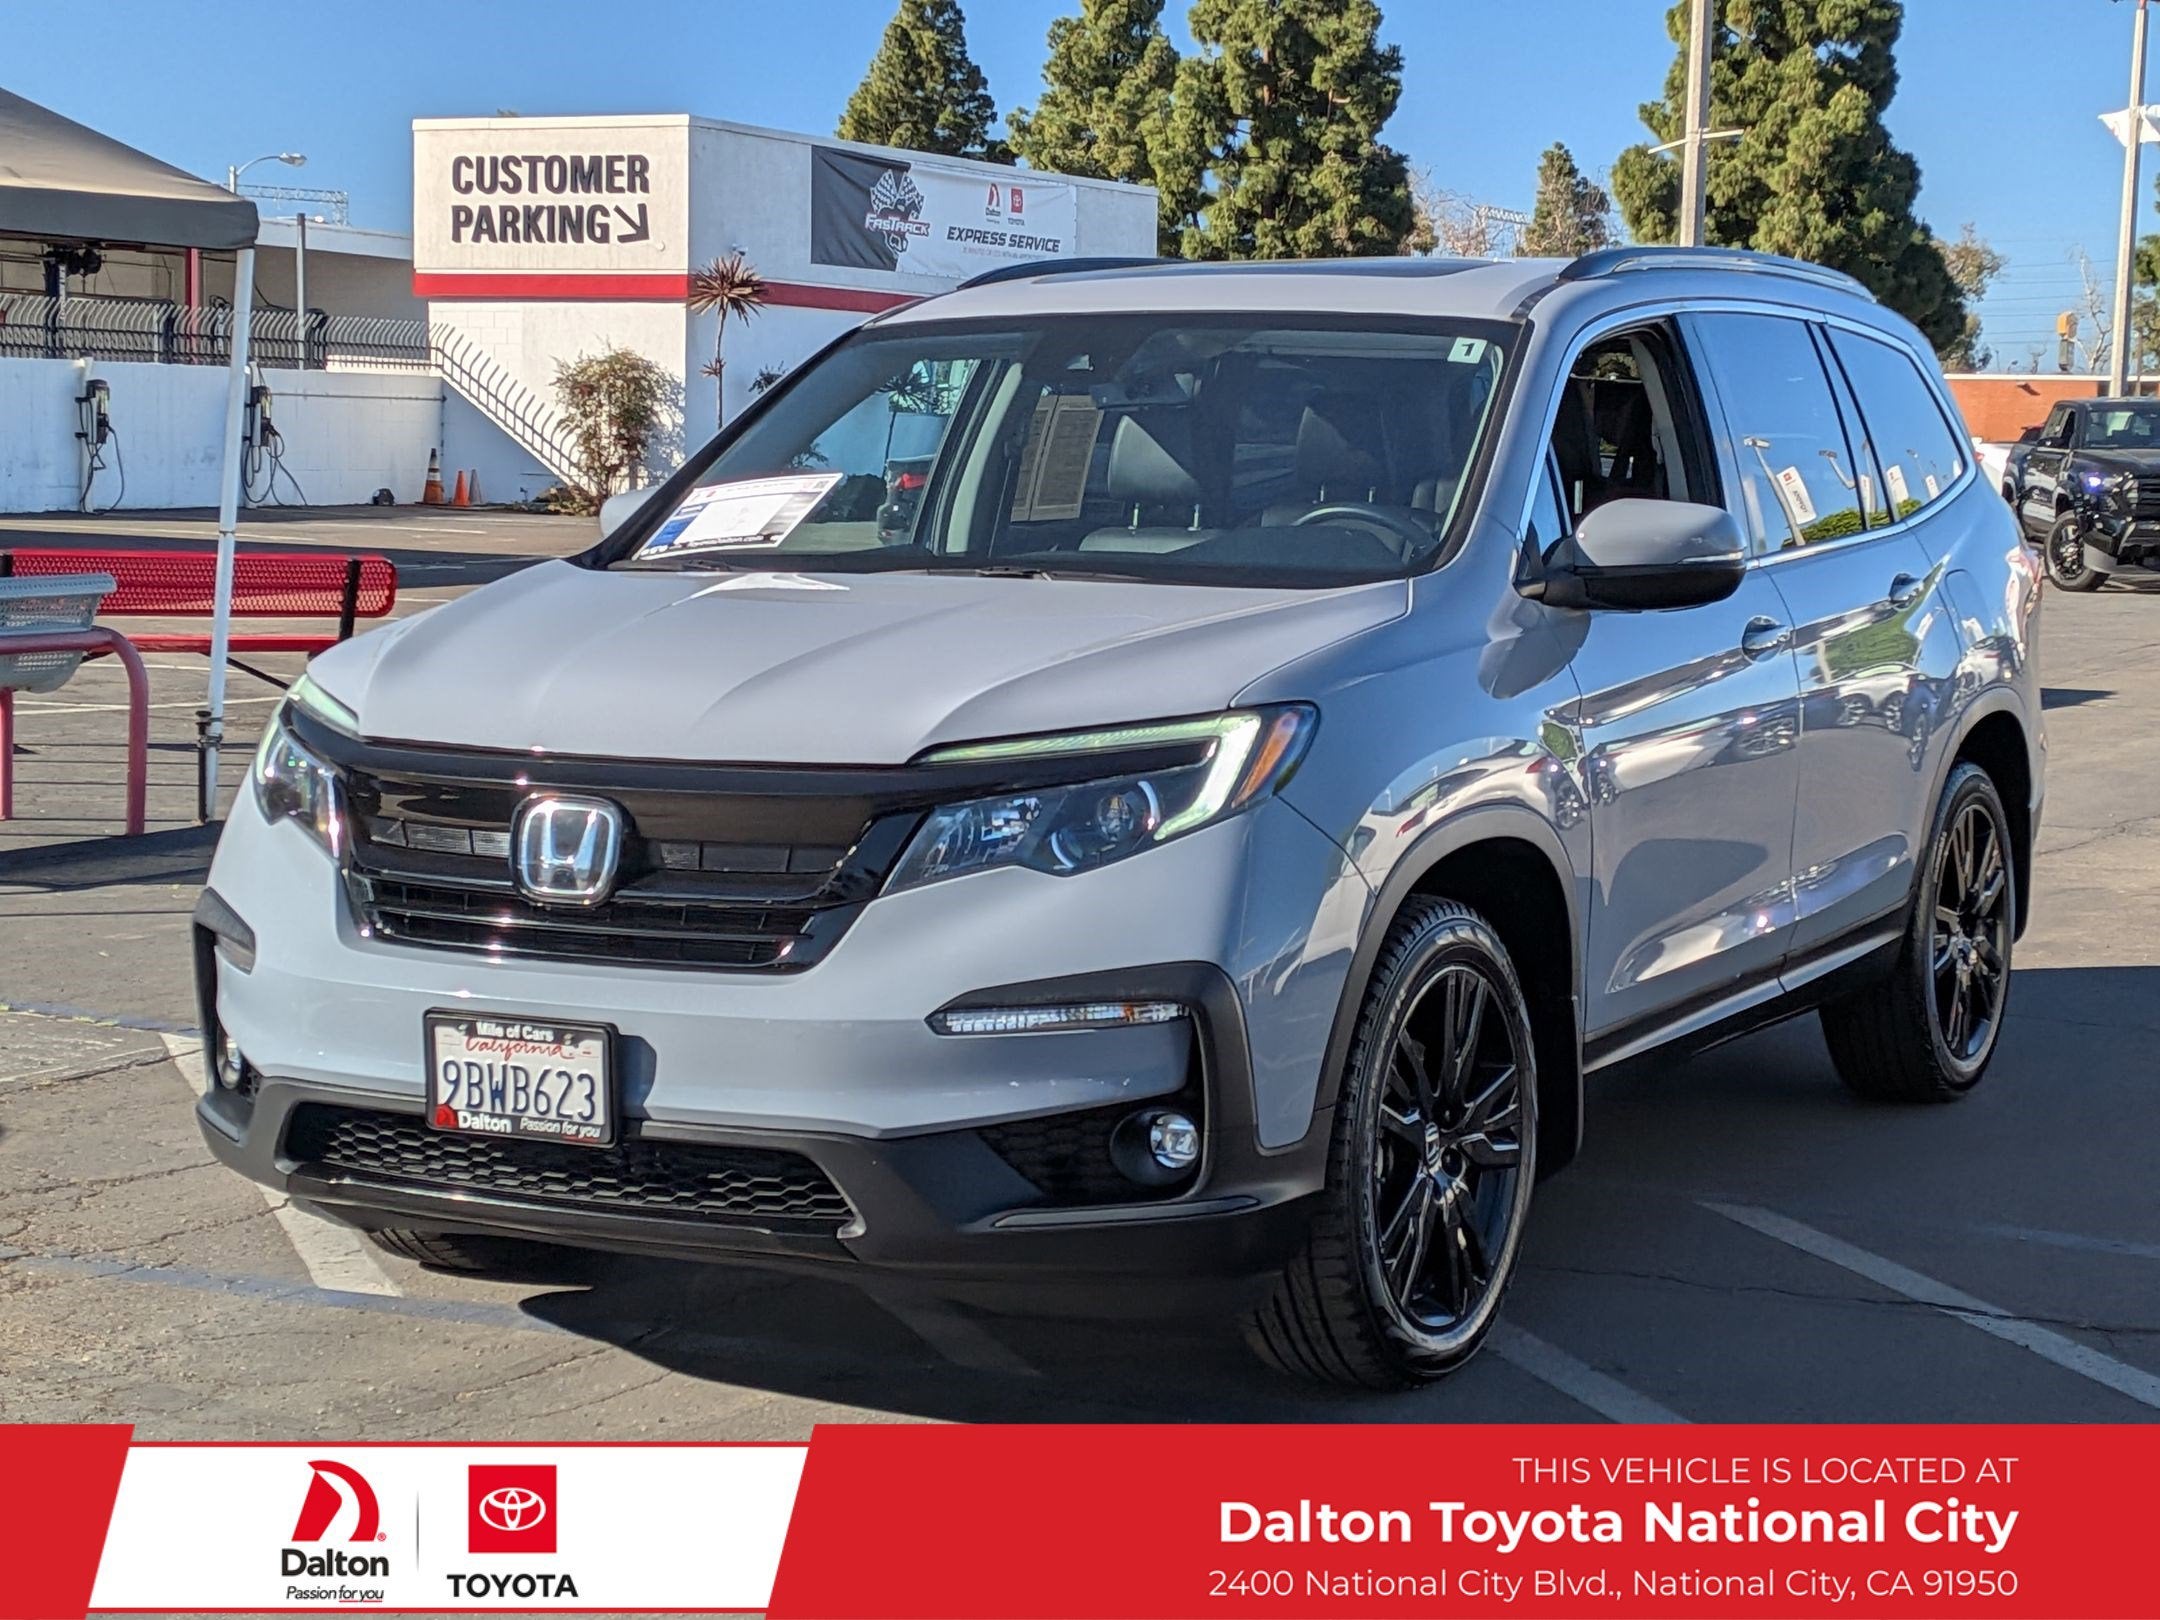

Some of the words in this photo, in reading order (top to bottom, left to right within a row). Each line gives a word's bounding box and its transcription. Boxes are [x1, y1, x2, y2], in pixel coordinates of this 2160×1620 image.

[452, 155, 649, 194] CUSTOMER
[452, 204, 609, 243] PARKING
[946, 226, 1007, 246] EXPRESS
[1008, 233, 1060, 252] SERVICE
[1461, 342, 1475, 357] 1
[476, 1022, 504, 1037] Mile
[506, 1025, 521, 1038] of
[522, 1026, 555, 1042] Cars
[442, 1059, 596, 1122] 9BWB623
[457, 1111, 512, 1133] Dalton
[519, 1117, 561, 1133] Passion
[561, 1121, 578, 1135] for
[578, 1124, 601, 1139] you
